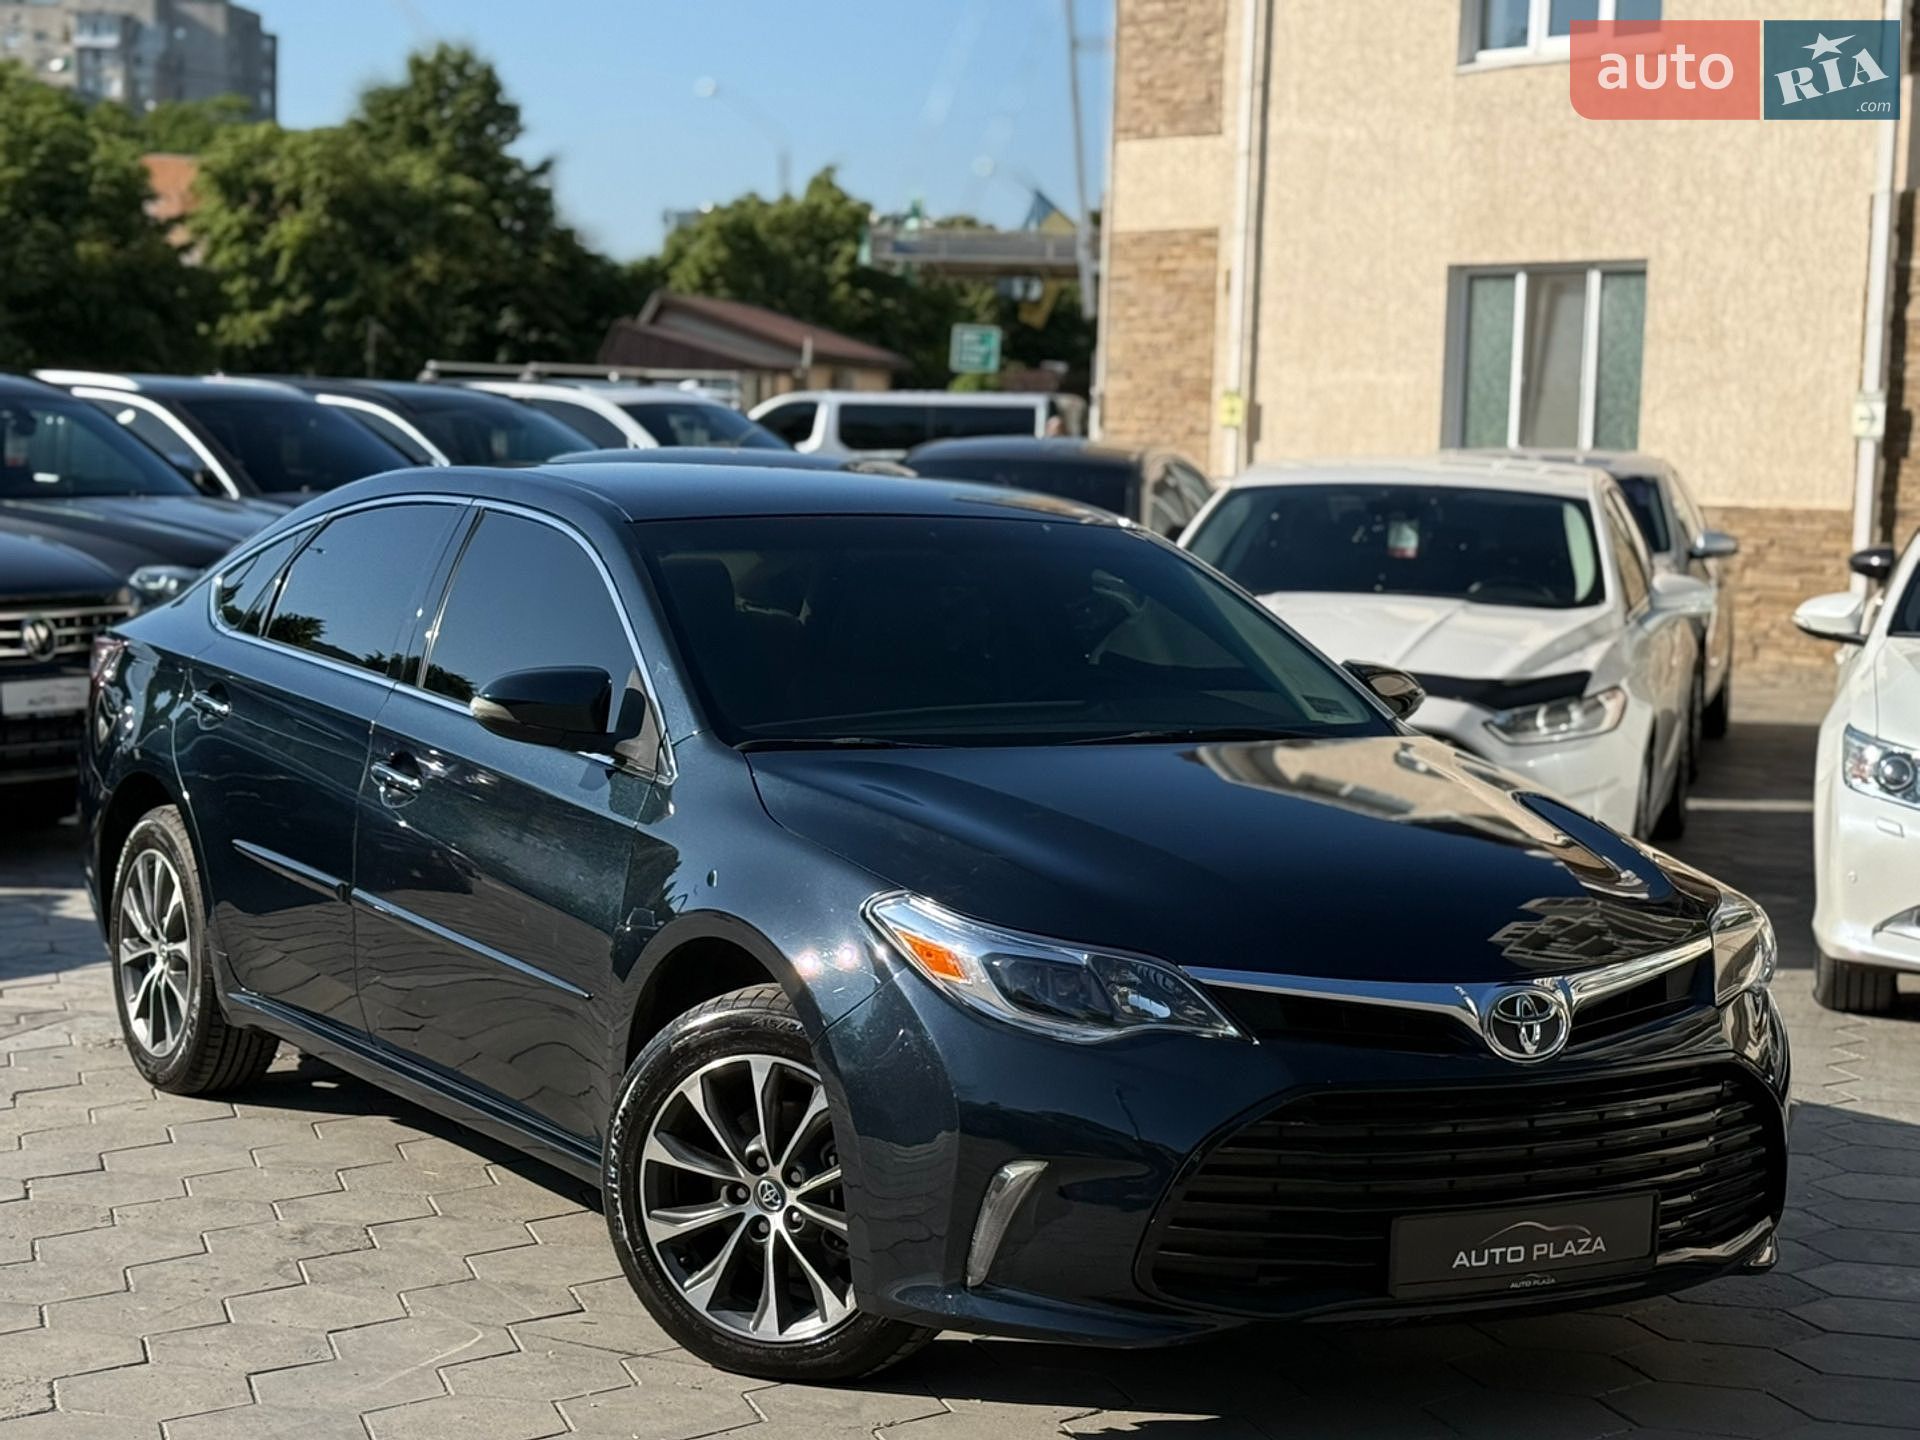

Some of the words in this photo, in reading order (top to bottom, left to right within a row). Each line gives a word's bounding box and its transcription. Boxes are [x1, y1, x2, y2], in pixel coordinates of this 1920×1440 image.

[1453, 1246, 1525, 1269] AUTO
[1532, 1236, 1606, 1261] PLAZA
[1510, 1280, 1531, 1289] AUTO
[1532, 1278, 1556, 1286] PLAZA
